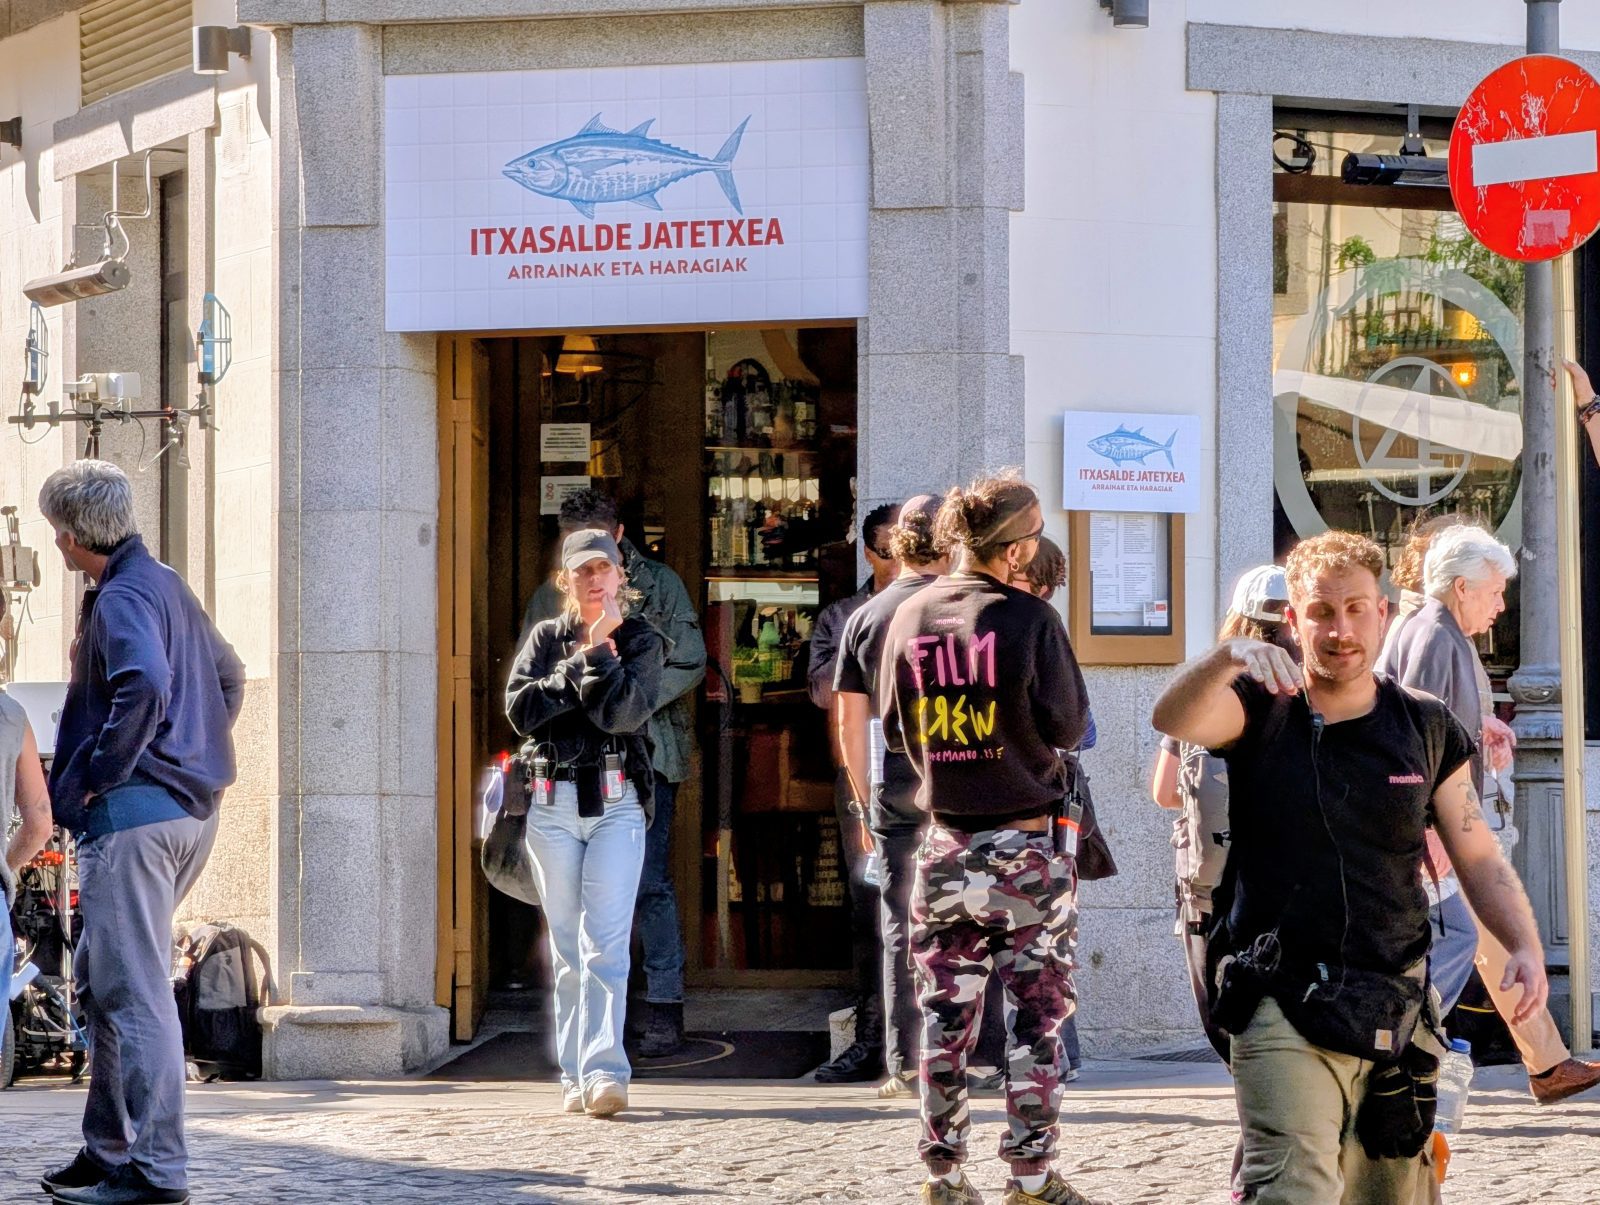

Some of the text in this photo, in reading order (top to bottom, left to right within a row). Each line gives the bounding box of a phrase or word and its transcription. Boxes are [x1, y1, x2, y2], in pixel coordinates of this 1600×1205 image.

[470, 217, 784, 256] ITXASALDE JATETXEA
[507, 257, 748, 280] ARRAINAK ETA HARAGIAK
[1079, 469, 1185, 483] ITXASALDE JATETXEA
[907, 631, 996, 689] FILM
[1389, 773, 1424, 784] mambo
